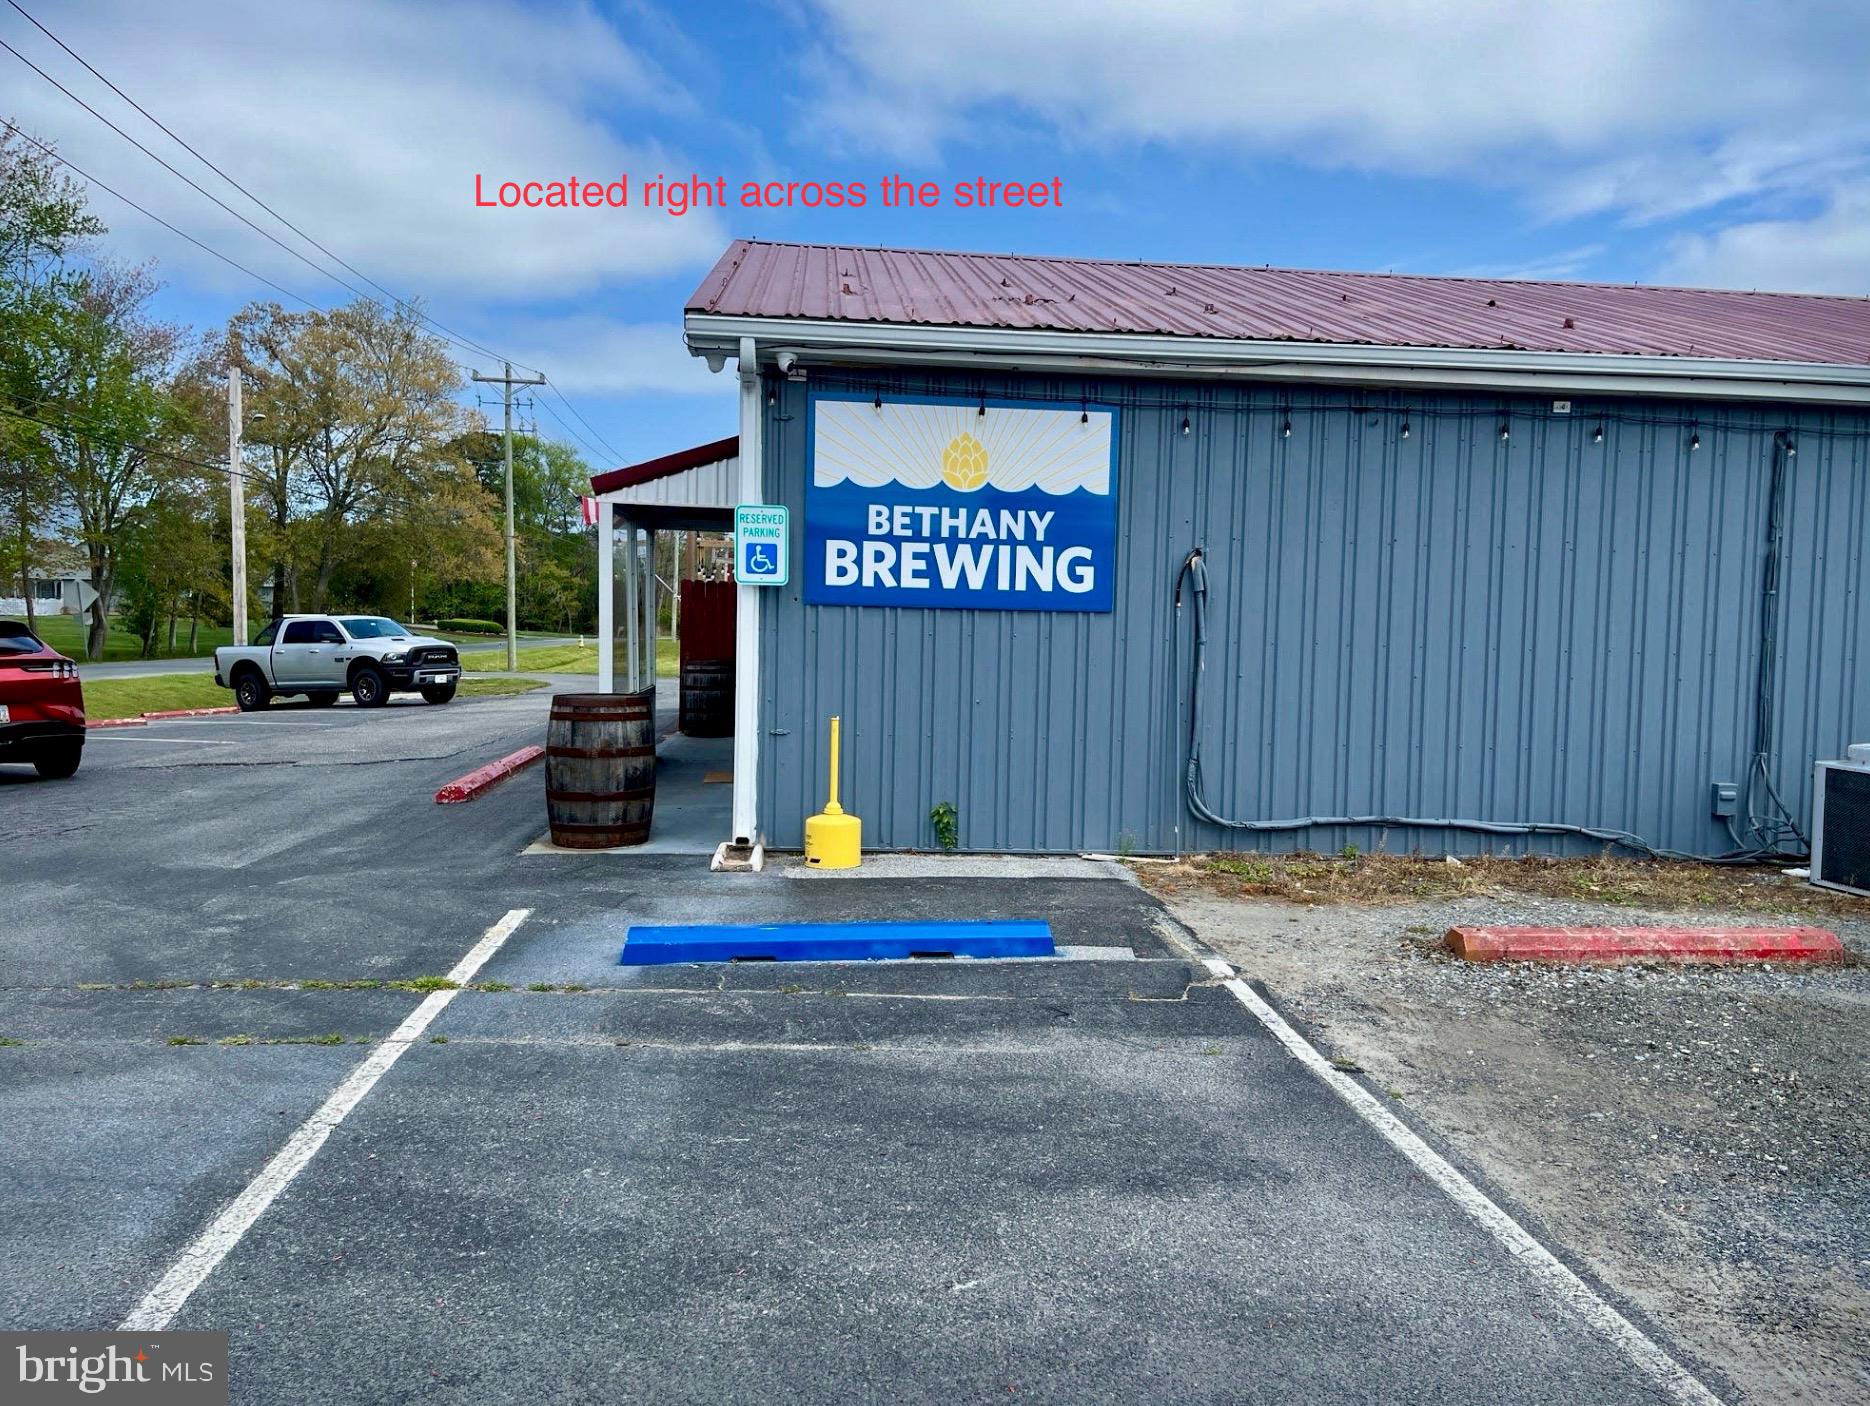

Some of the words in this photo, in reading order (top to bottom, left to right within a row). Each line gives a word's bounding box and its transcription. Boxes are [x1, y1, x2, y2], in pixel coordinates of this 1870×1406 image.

[739, 513, 784, 525] RESERVED
[868, 504, 1055, 542] BETHANY
[743, 527, 780, 538] PARKING
[825, 539, 1095, 594] BREWING
